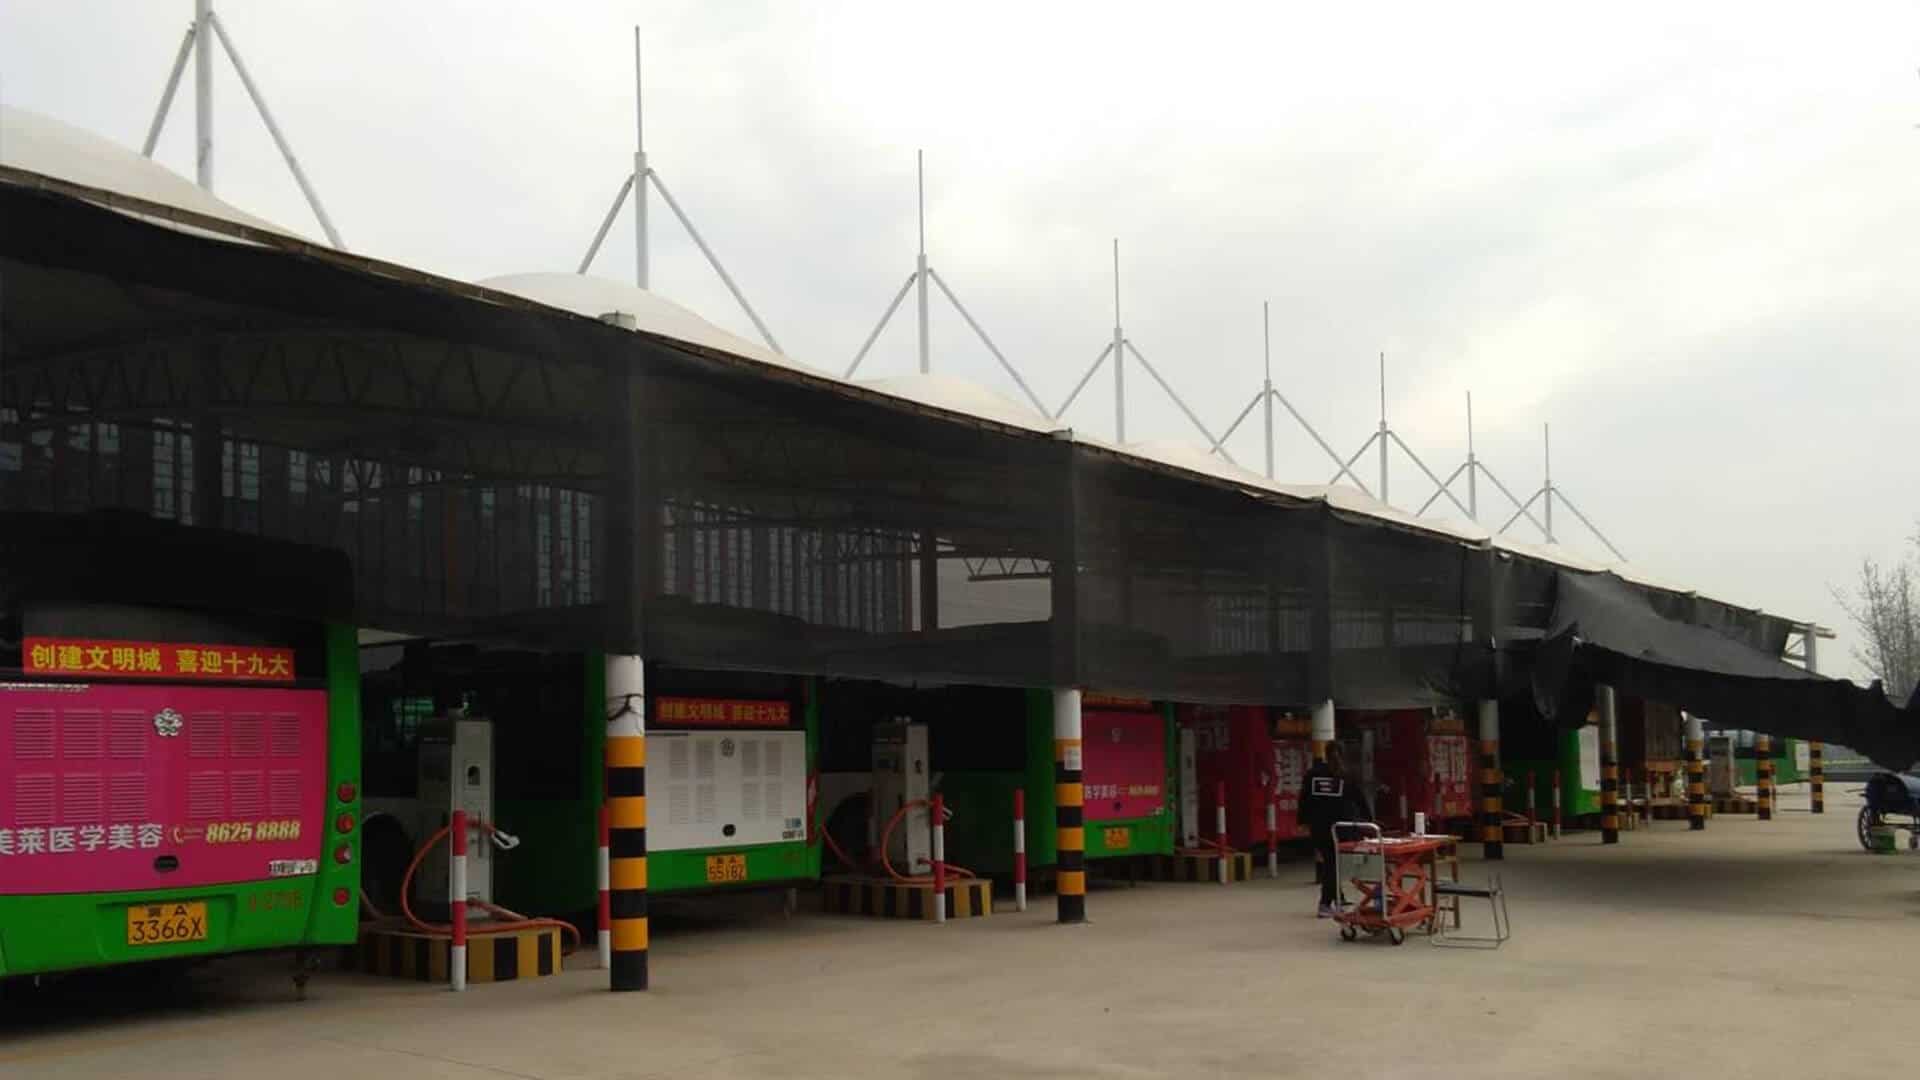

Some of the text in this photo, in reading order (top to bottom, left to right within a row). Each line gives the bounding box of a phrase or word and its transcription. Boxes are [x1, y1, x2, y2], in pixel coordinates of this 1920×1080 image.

[31, 645, 289, 676] 创建文明城 喜迎十九大
[207, 821, 300, 843] 8625 8888
[131, 917, 203, 942] 3366X
